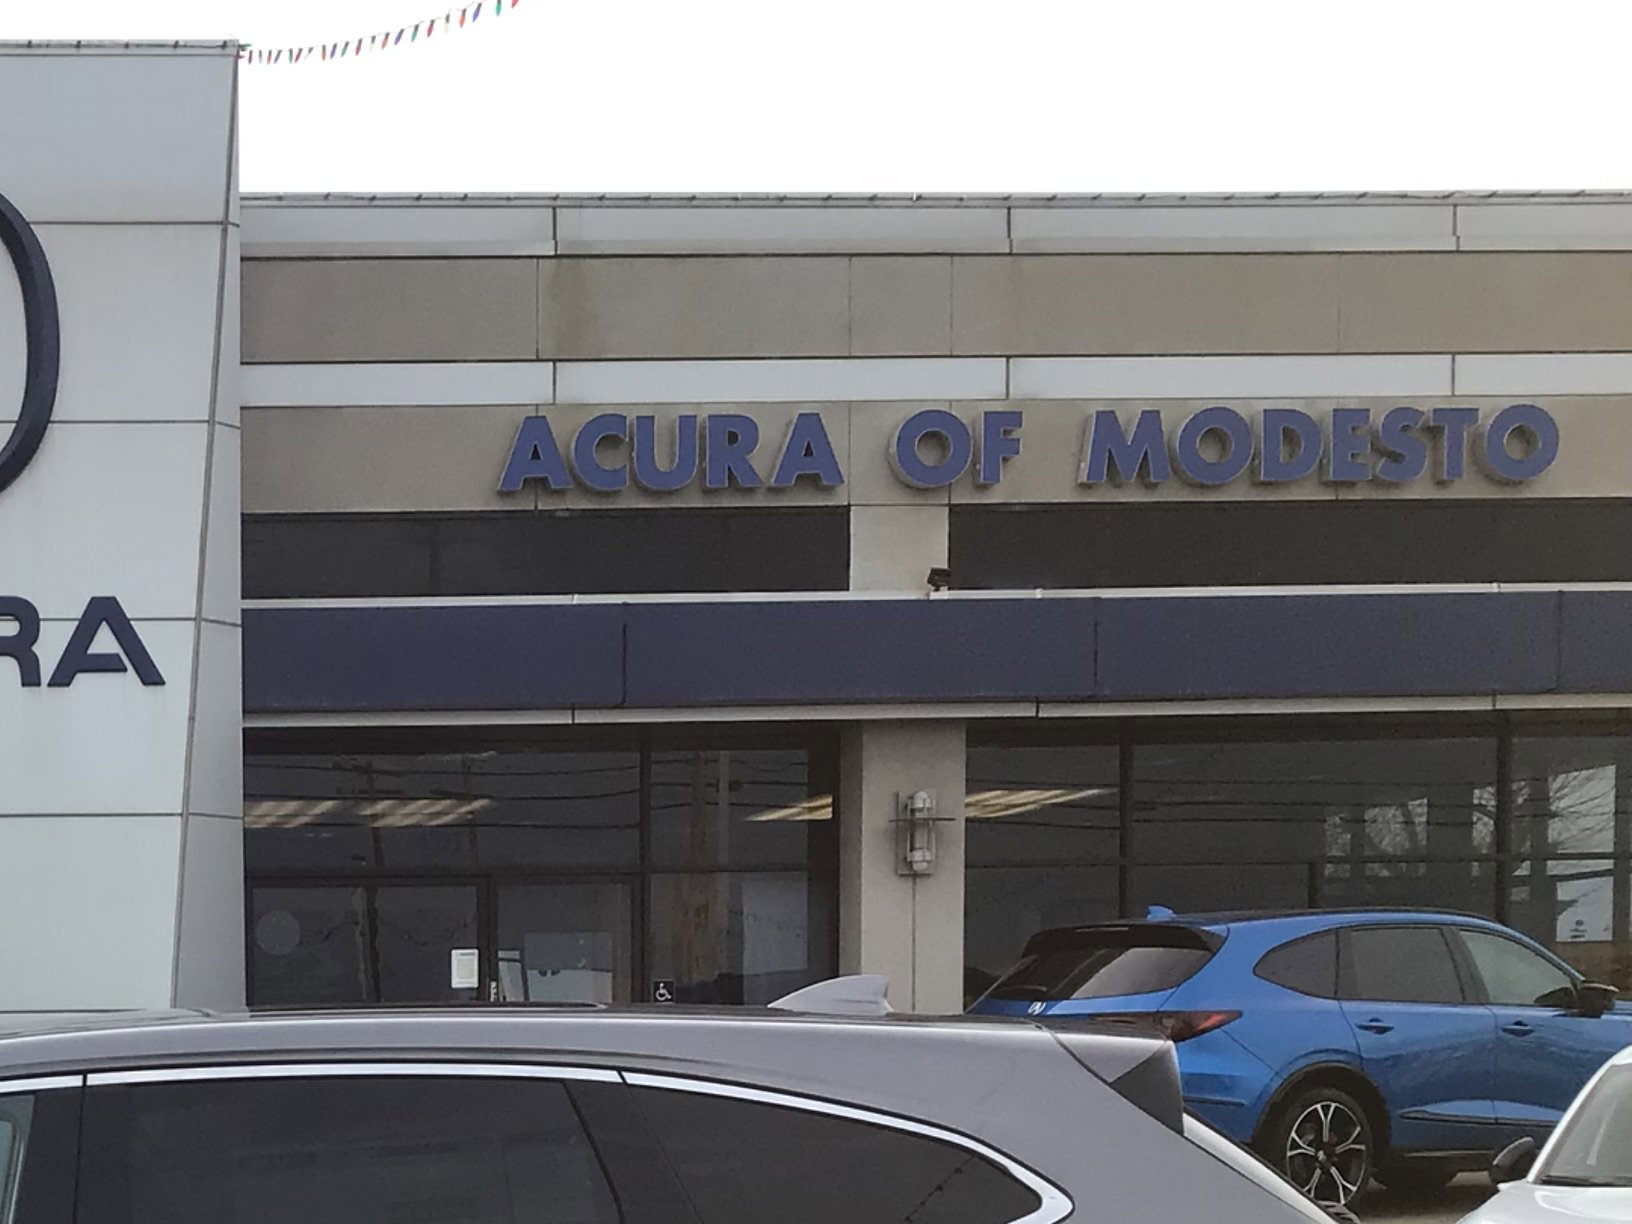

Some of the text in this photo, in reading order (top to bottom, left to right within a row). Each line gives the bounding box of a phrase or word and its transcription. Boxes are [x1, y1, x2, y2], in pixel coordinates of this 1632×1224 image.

[498, 404, 1561, 492] ACURA OF MODESTO
